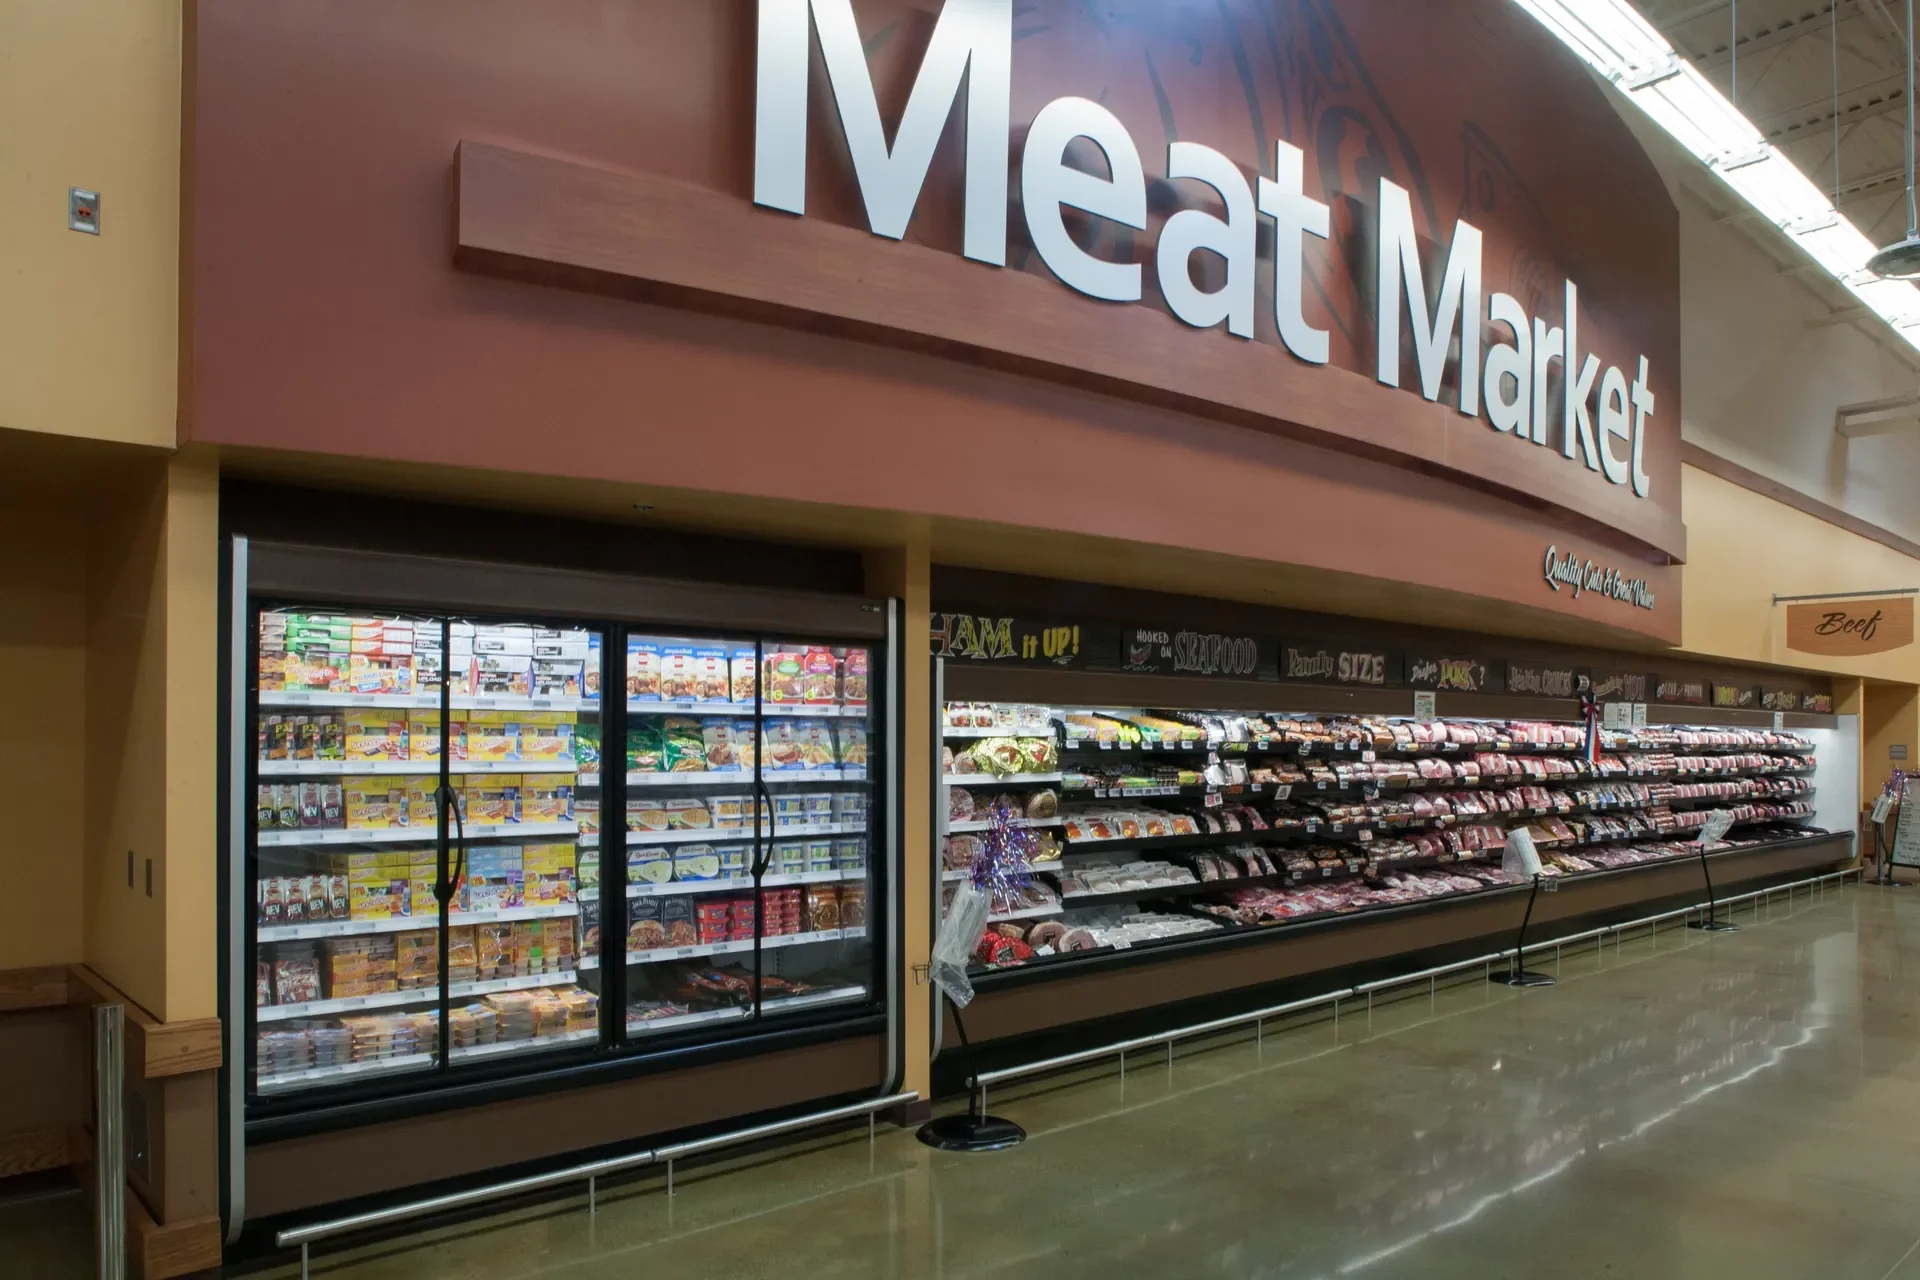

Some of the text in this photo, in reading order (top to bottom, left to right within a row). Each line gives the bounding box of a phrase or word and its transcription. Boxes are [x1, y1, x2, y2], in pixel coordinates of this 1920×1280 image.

[754, 0, 1655, 498] Meat Market
[1544, 545, 1583, 599] Quality
[1583, 559, 1602, 592] Cuts
[1603, 567, 1612, 597] &
[930, 612, 1080, 659] HAM it UP!
[1136, 628, 1169, 644] HOOKED
[1815, 610, 1883, 641] Beef
[1160, 645, 1171, 659] ON
[1173, 629, 1257, 675] SEAFOOD
[1287, 648, 1385, 685] Family SIZE
[1437, 658, 1478, 692] PORK
[325, 807, 339, 818] REV
[266, 904, 280, 916] REV
[332, 897, 346, 909] REV
